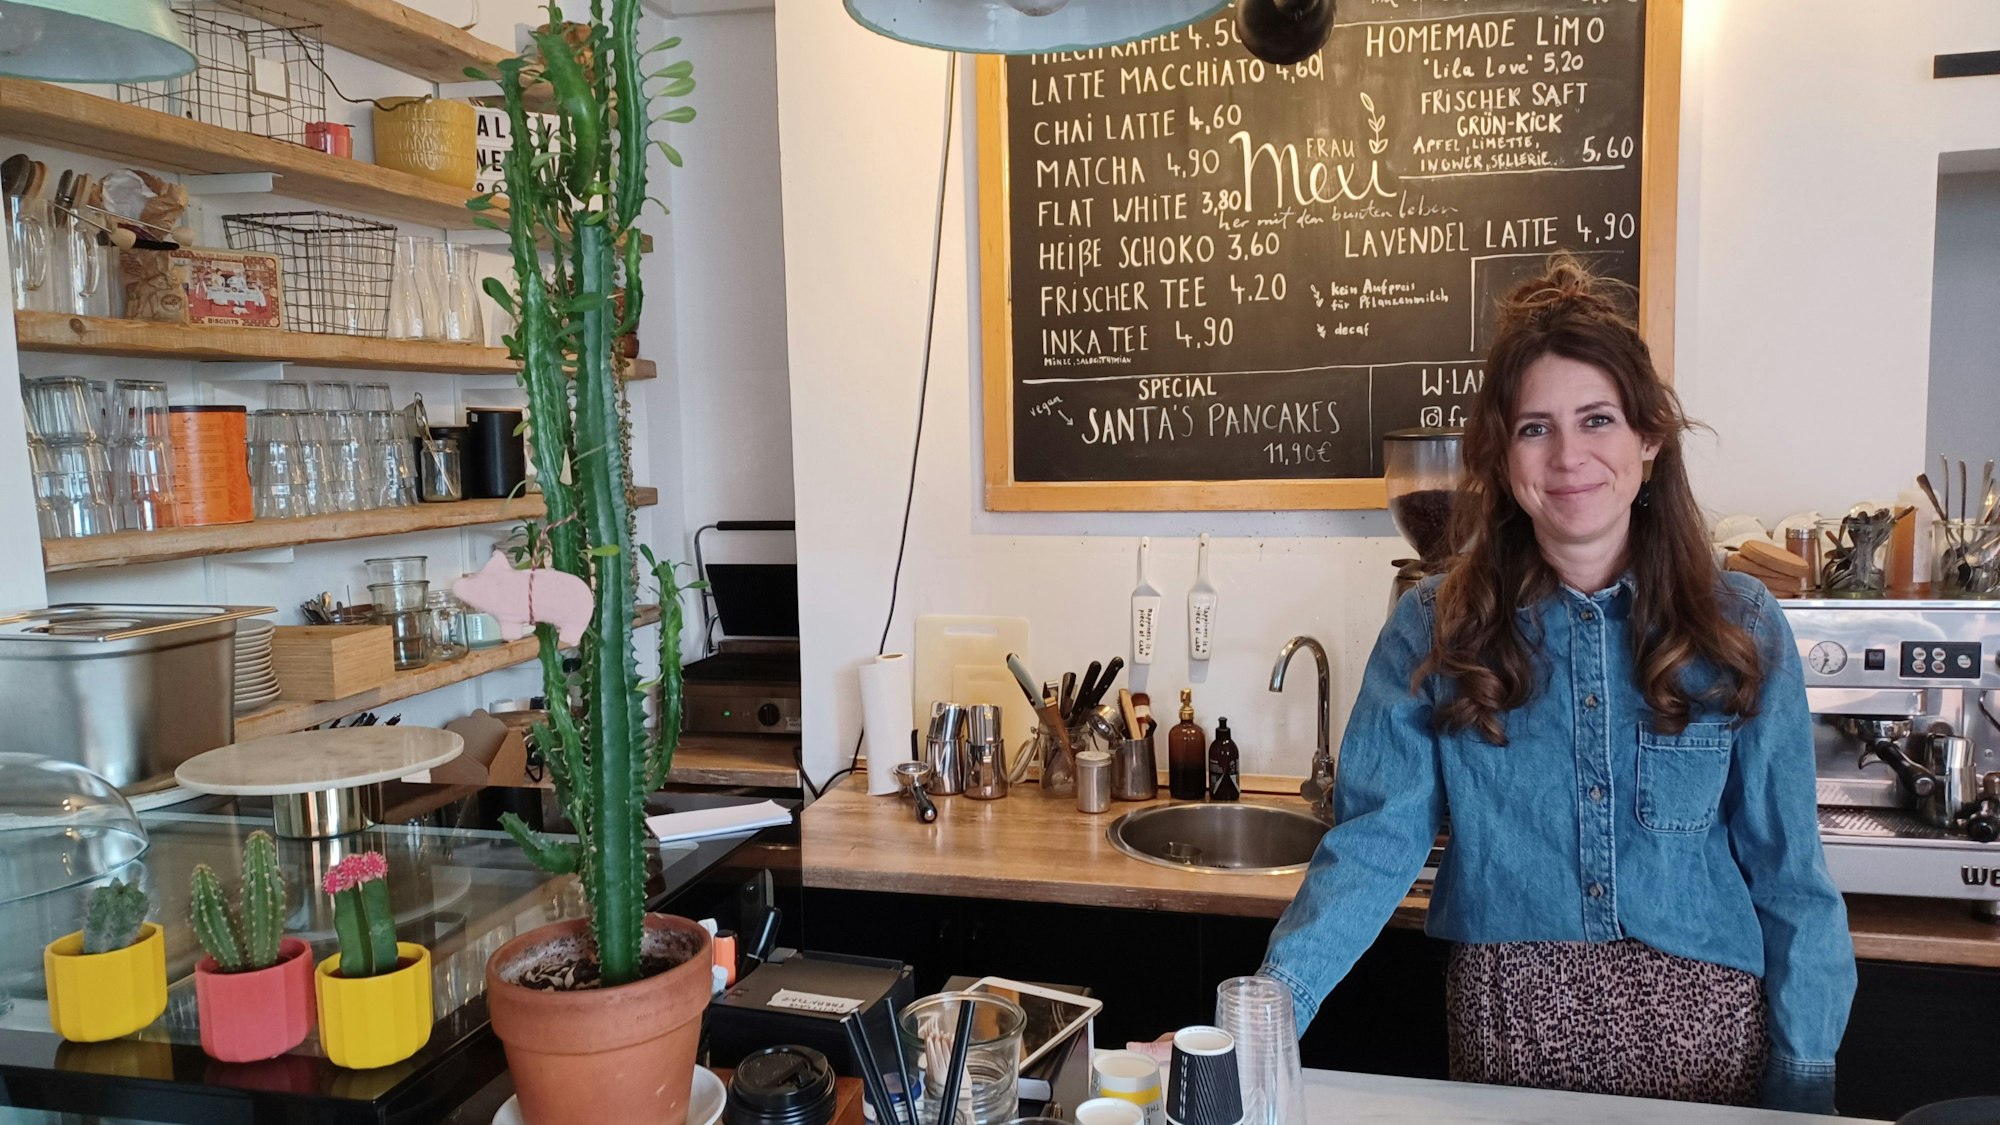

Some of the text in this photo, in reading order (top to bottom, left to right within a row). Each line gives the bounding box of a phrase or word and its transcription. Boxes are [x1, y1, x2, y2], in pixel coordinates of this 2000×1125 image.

[1366, 18, 1516, 57] HOMEMADE
[1032, 69, 1104, 105] LATTE
[1532, 82, 1588, 106] SAFT
[1106, 109, 1175, 140] LATTE
[1189, 104, 1242, 135] 4,60
[1306, 138, 1355, 158] FRAU
[1583, 136, 1634, 162] 5,60
[1037, 149, 1220, 188] MATCHA 4,90
[1038, 198, 1094, 227] FLAT
[1202, 189, 1242, 216] 3,80
[1119, 236, 1214, 268] SCHOKO
[1345, 222, 1470, 258] LAVENDEL
[1486, 217, 1558, 249] LATTE
[1160, 276, 1207, 309] TEE
[1331, 278, 1415, 296] kein Aufpreis
[208, 317, 239, 325] BISCUITS
[1334, 322, 1369, 336] decaf
[1042, 328, 1101, 355] INKA
[1108, 325, 1149, 352] TEE
[1029, 395, 1064, 418] vegan
[1082, 400, 1341, 445] SANTA'S PANCAKES
[1263, 441, 1332, 466] 11,90€
